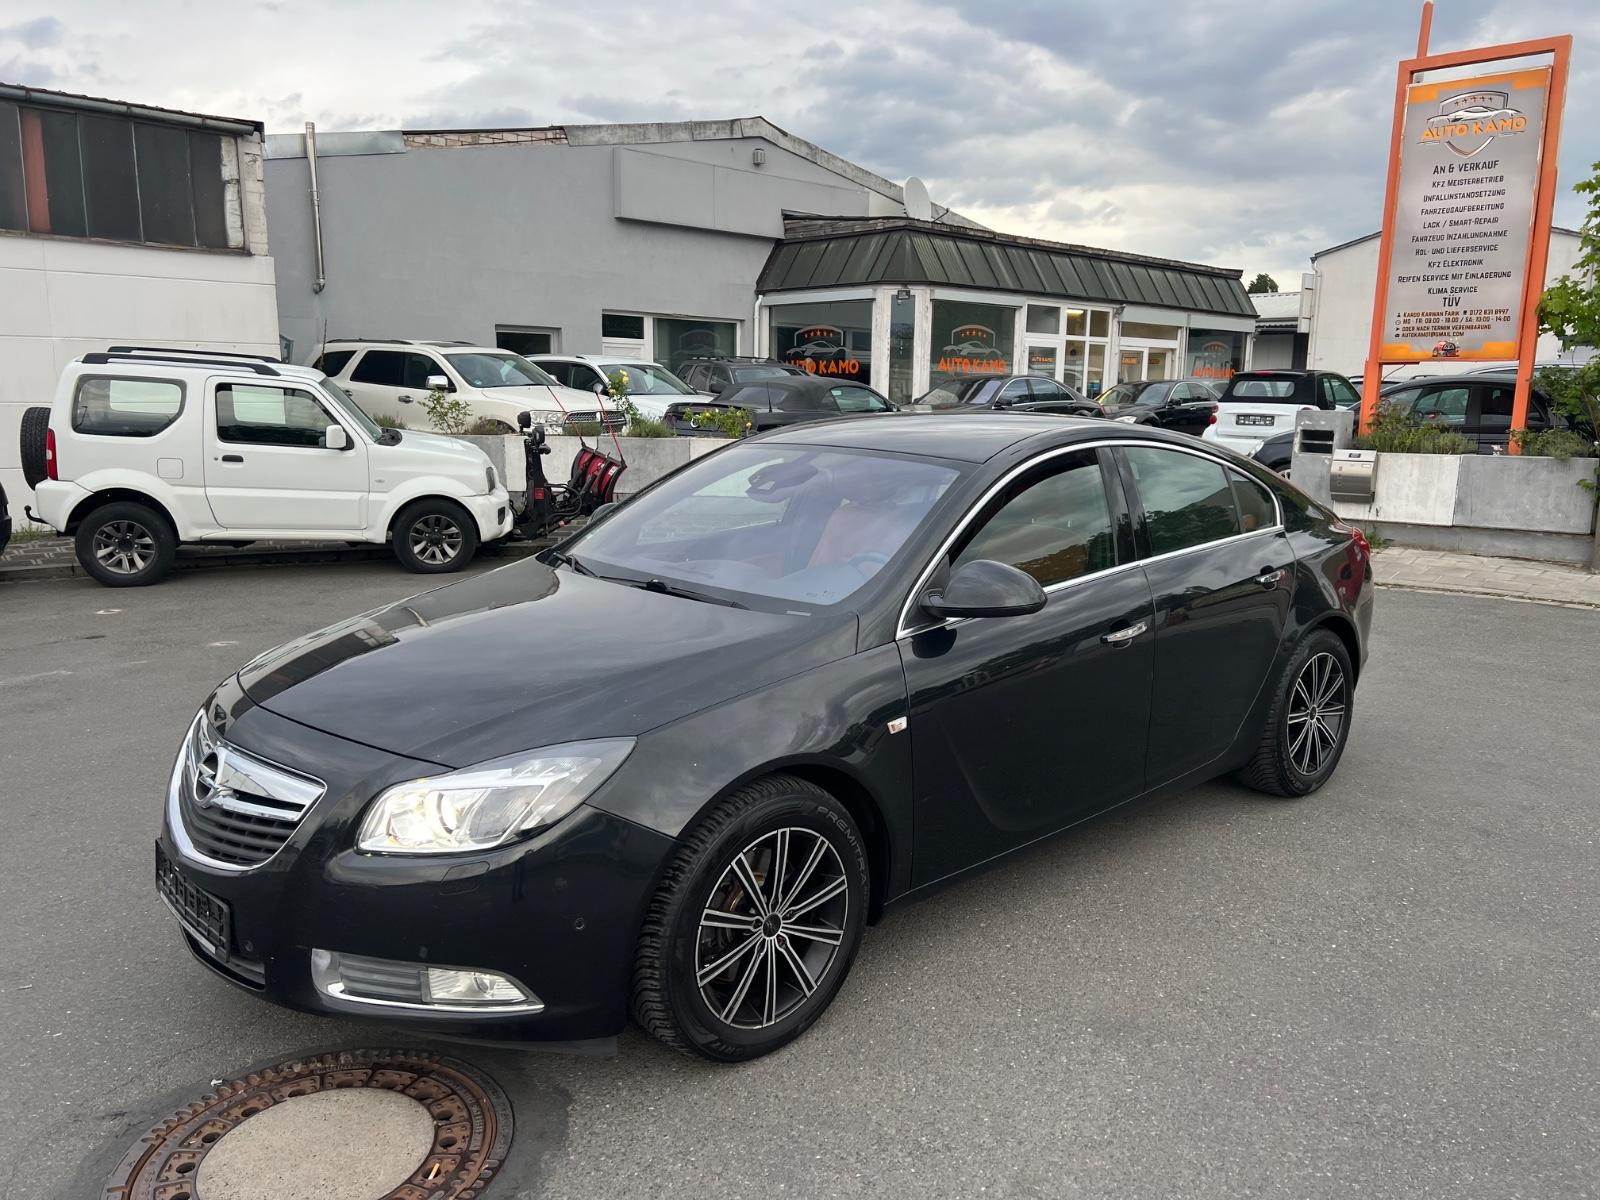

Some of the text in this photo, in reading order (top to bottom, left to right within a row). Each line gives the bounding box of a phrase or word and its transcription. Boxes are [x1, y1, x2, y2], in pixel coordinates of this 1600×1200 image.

[1422, 116, 1527, 141] AUTO KAMO
[1432, 160, 1500, 175] AN & VERKAUF
[1432, 175, 1504, 188] KFZ MEISTERBETRIEB
[1423, 189, 1506, 202] UNFALLINSTANDSETZUNG
[1420, 203, 1505, 215] FAHRZEUGAUFBEREITUNG
[1422, 217, 1499, 229] LACK / SMART-REPAIR
[1411, 230, 1508, 243] FAHRZEUG INZAHLUNGNAHME
[1431, 247, 1445, 255] UND
[1446, 244, 1499, 254] LIEFERSERVICE
[1427, 259, 1484, 268] KFZ ELEKTRONIK
[1397, 271, 1512, 283] REIFEN SERVICE MIT EINLAGERUNG
[1427, 286, 1478, 295] KLIMA SERVICE
[1442, 294, 1461, 307] TÜV
[937, 356, 971, 374] AUTO
[816, 805, 867, 885] PREMITRA
